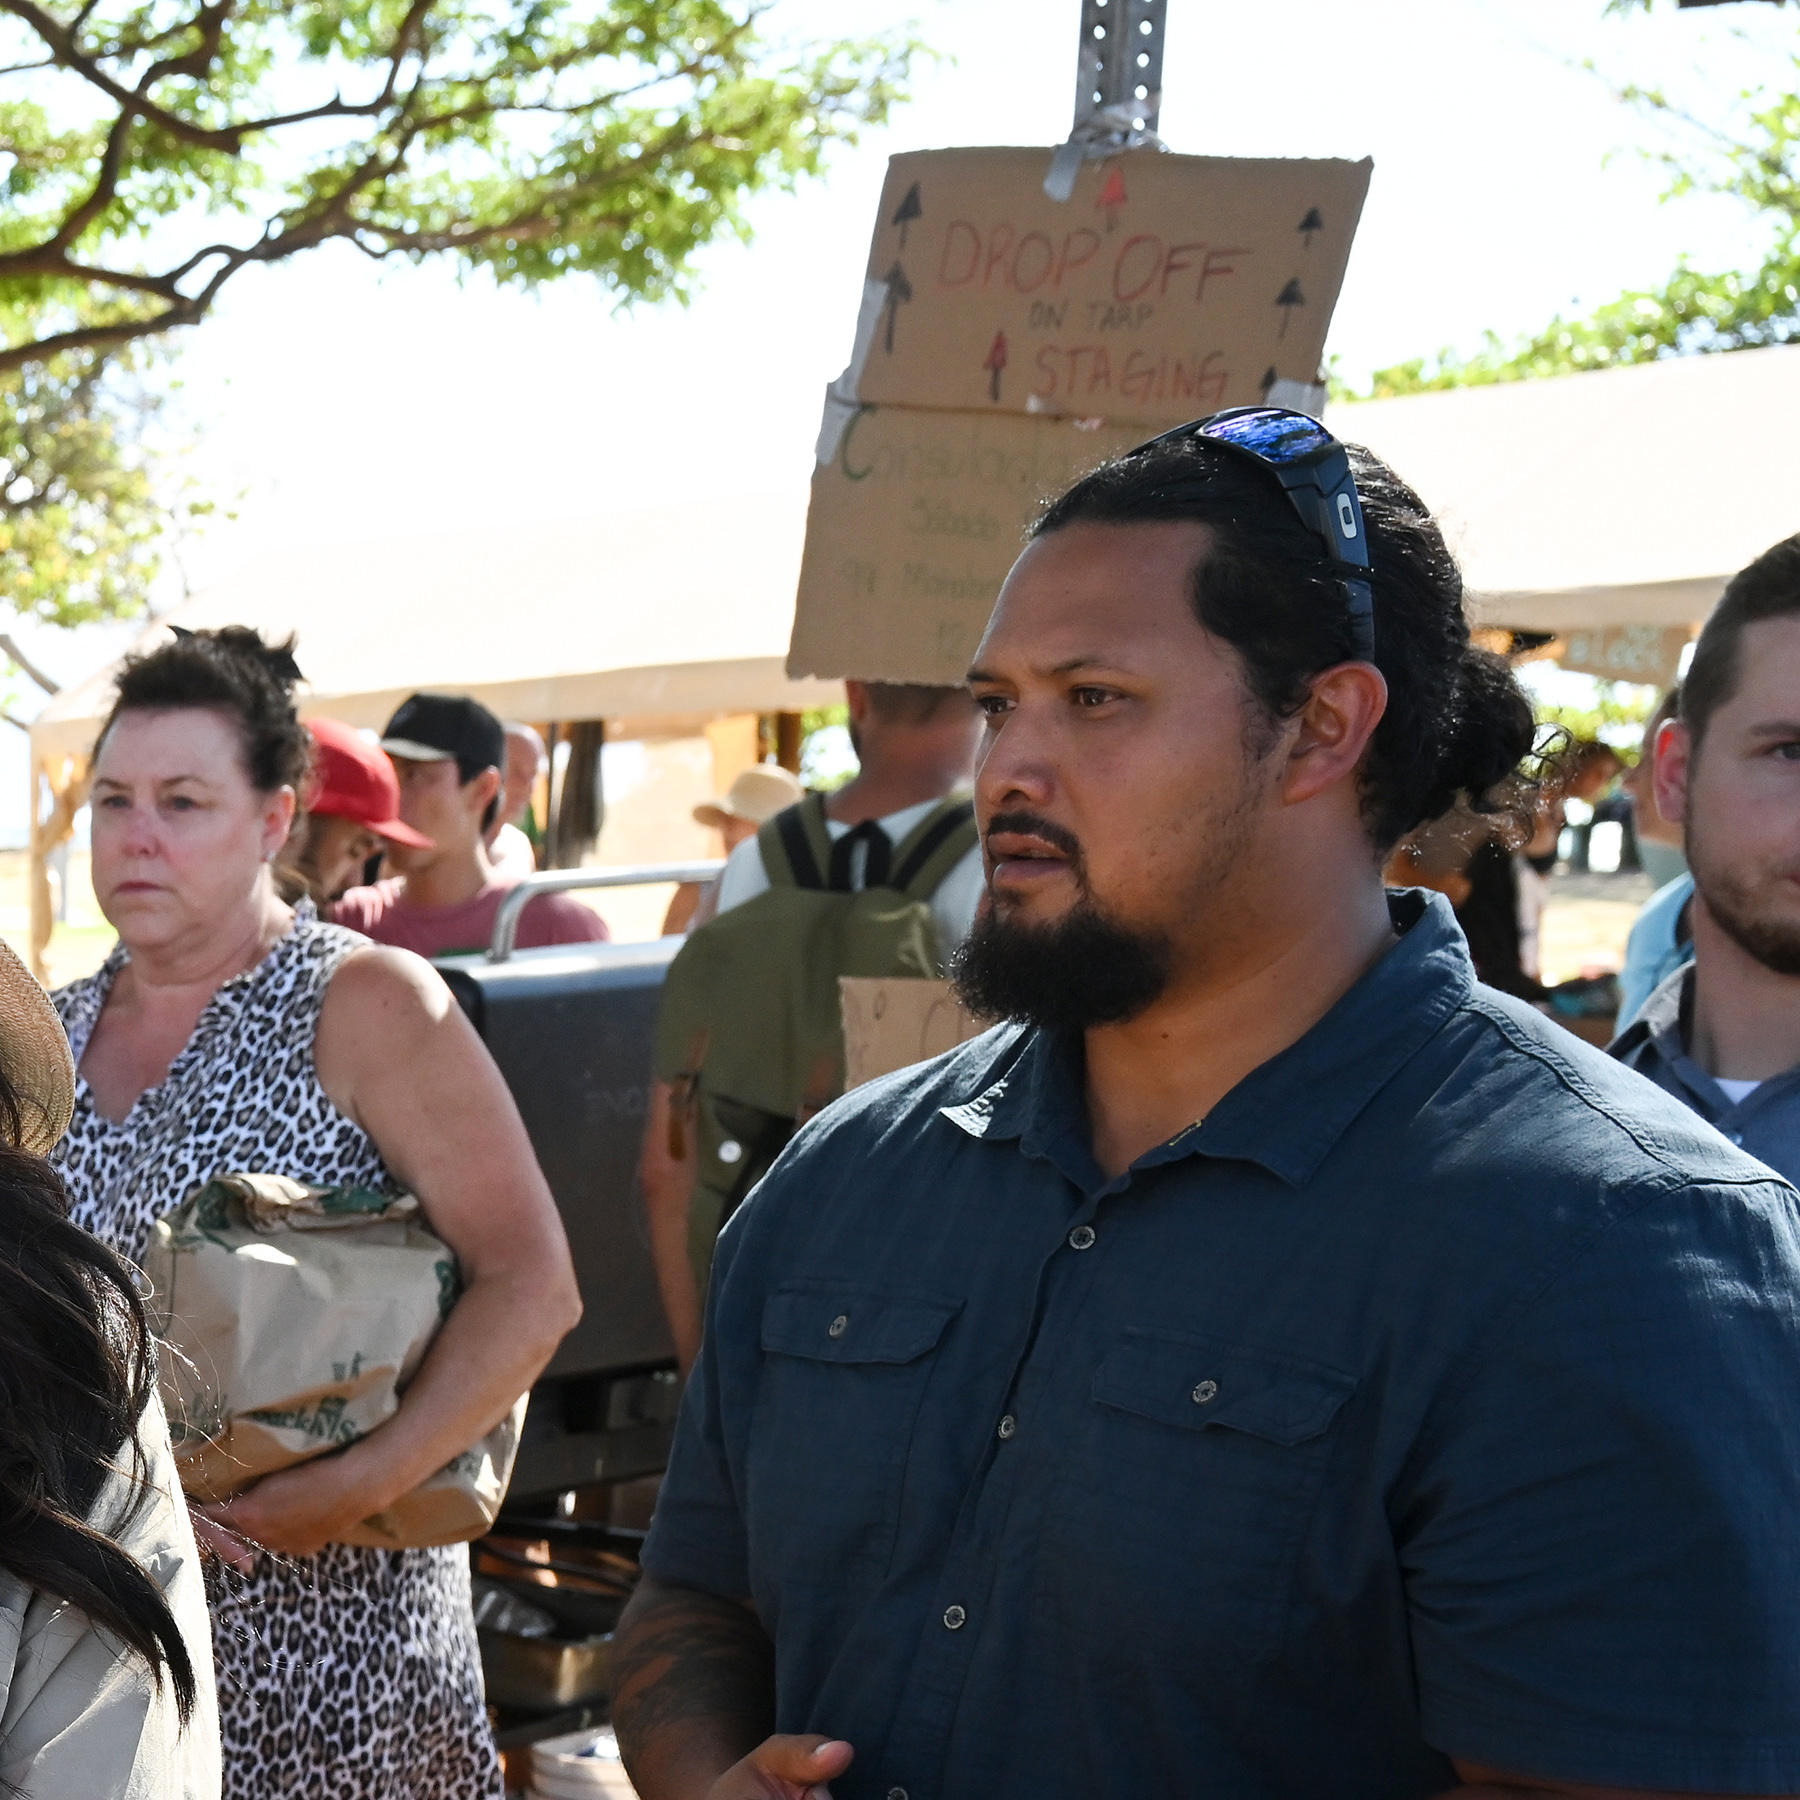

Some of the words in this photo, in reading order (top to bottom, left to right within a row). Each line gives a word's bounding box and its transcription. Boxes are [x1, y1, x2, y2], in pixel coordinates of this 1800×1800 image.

[937, 218, 1103, 294] DROP
[1112, 233, 1253, 304] OFF
[1028, 300, 1069, 331] ON
[1086, 301, 1155, 332] TARP
[1035, 343, 1230, 404] STAGING
